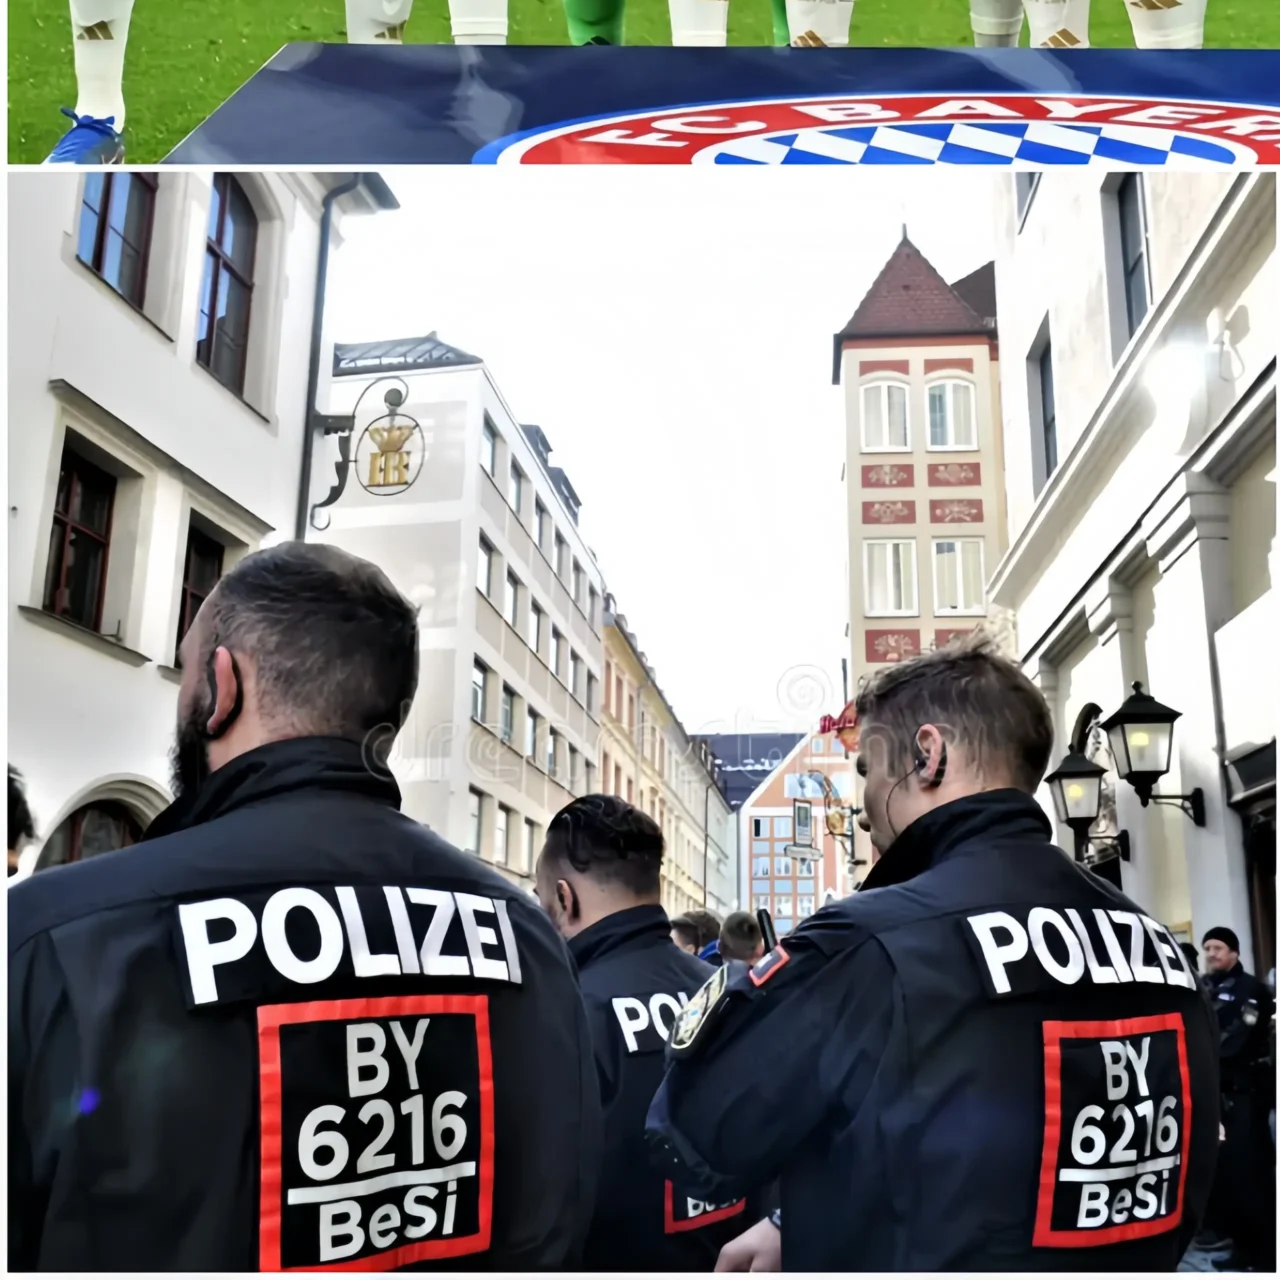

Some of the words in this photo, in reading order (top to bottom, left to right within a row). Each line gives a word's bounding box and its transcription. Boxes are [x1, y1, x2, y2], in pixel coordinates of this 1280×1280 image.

[583, 115, 767, 149] FC
[178, 885, 523, 1005] POLIZEI
[612, 991, 690, 1053] PO
[345, 1018, 431, 1099] BY
[1100, 1037, 1151, 1101] BY
[297, 1090, 469, 1181] 6216
[1071, 1095, 1179, 1166] 6216
[318, 1179, 459, 1263] BeSi
[1076, 1169, 1170, 1228] BeSi
